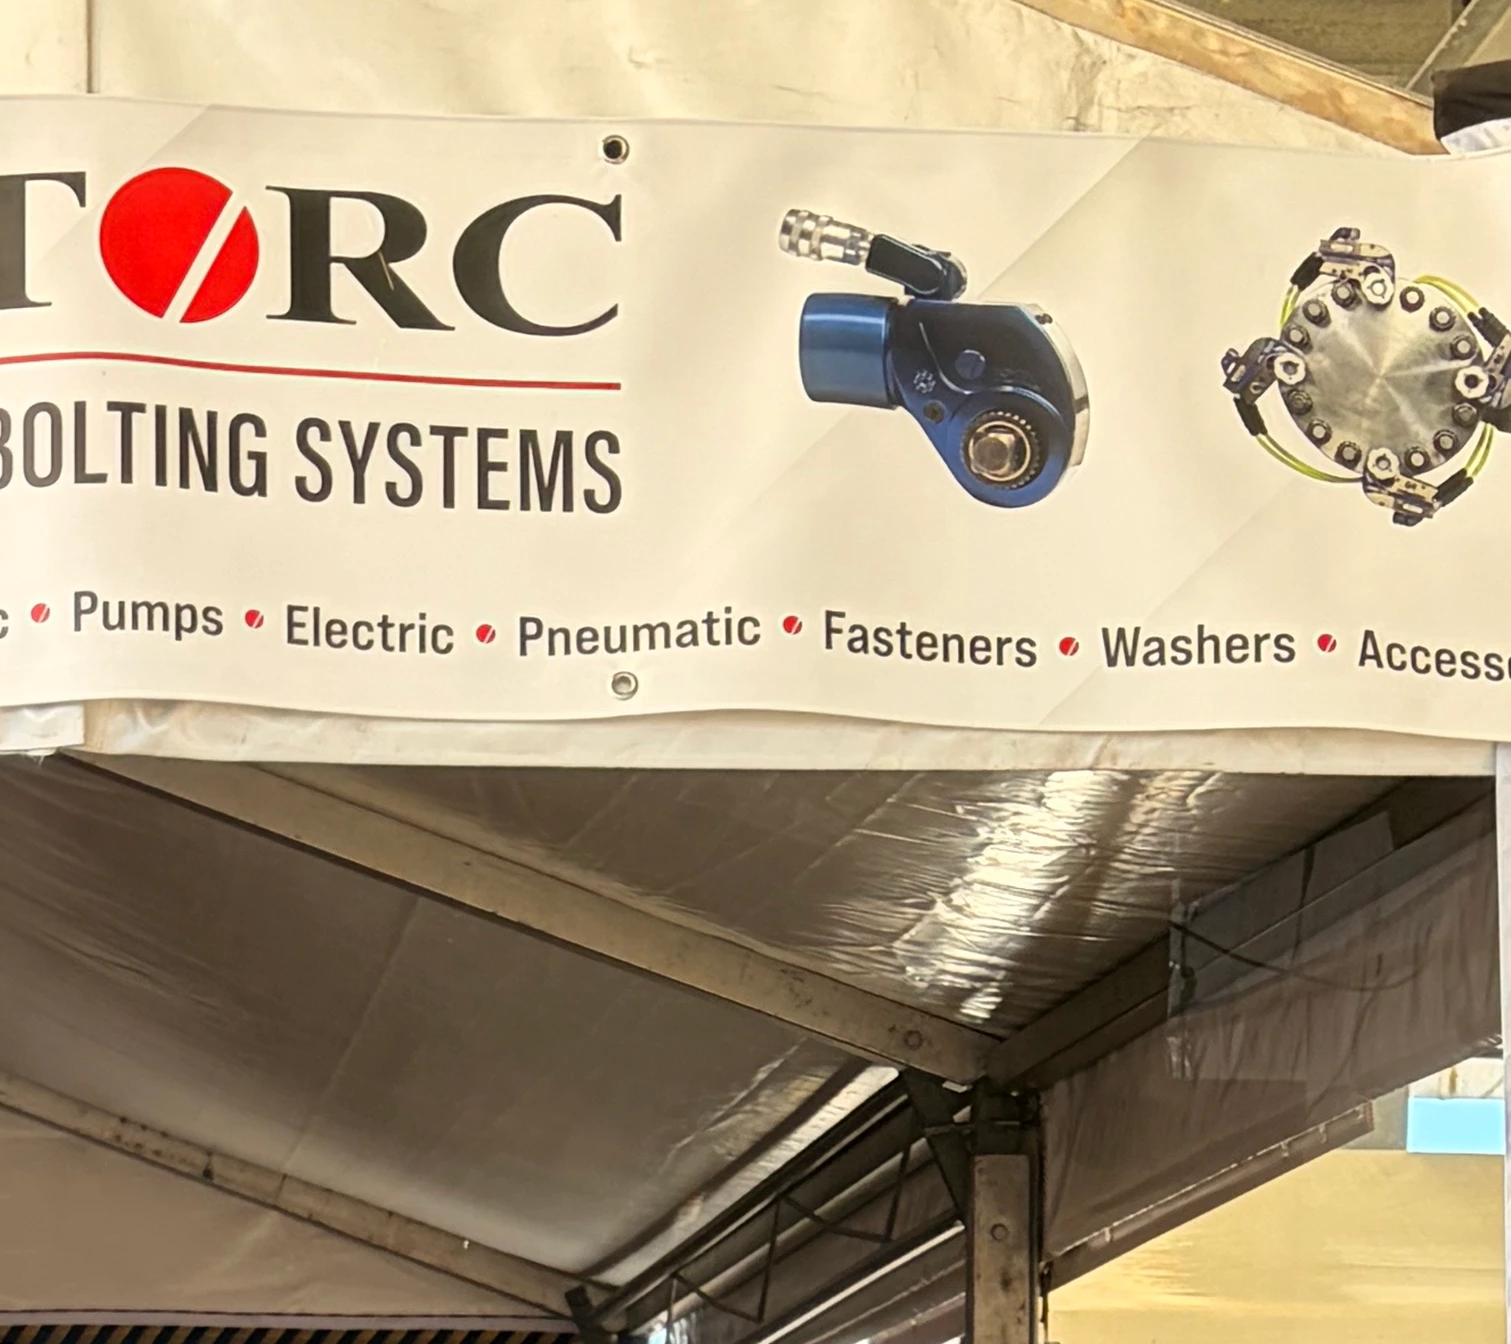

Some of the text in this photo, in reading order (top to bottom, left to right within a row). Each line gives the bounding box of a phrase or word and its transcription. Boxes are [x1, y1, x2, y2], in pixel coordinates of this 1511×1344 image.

[295, 417, 622, 514] SYSTEMS
[73, 591, 223, 647] Pumps
[286, 604, 454, 655] Electric
[518, 606, 762, 657] Pneumatic
[824, 611, 1038, 669] Fasteners
[1102, 625, 1296, 669] Washers
[1358, 629, 1511, 682] Access
